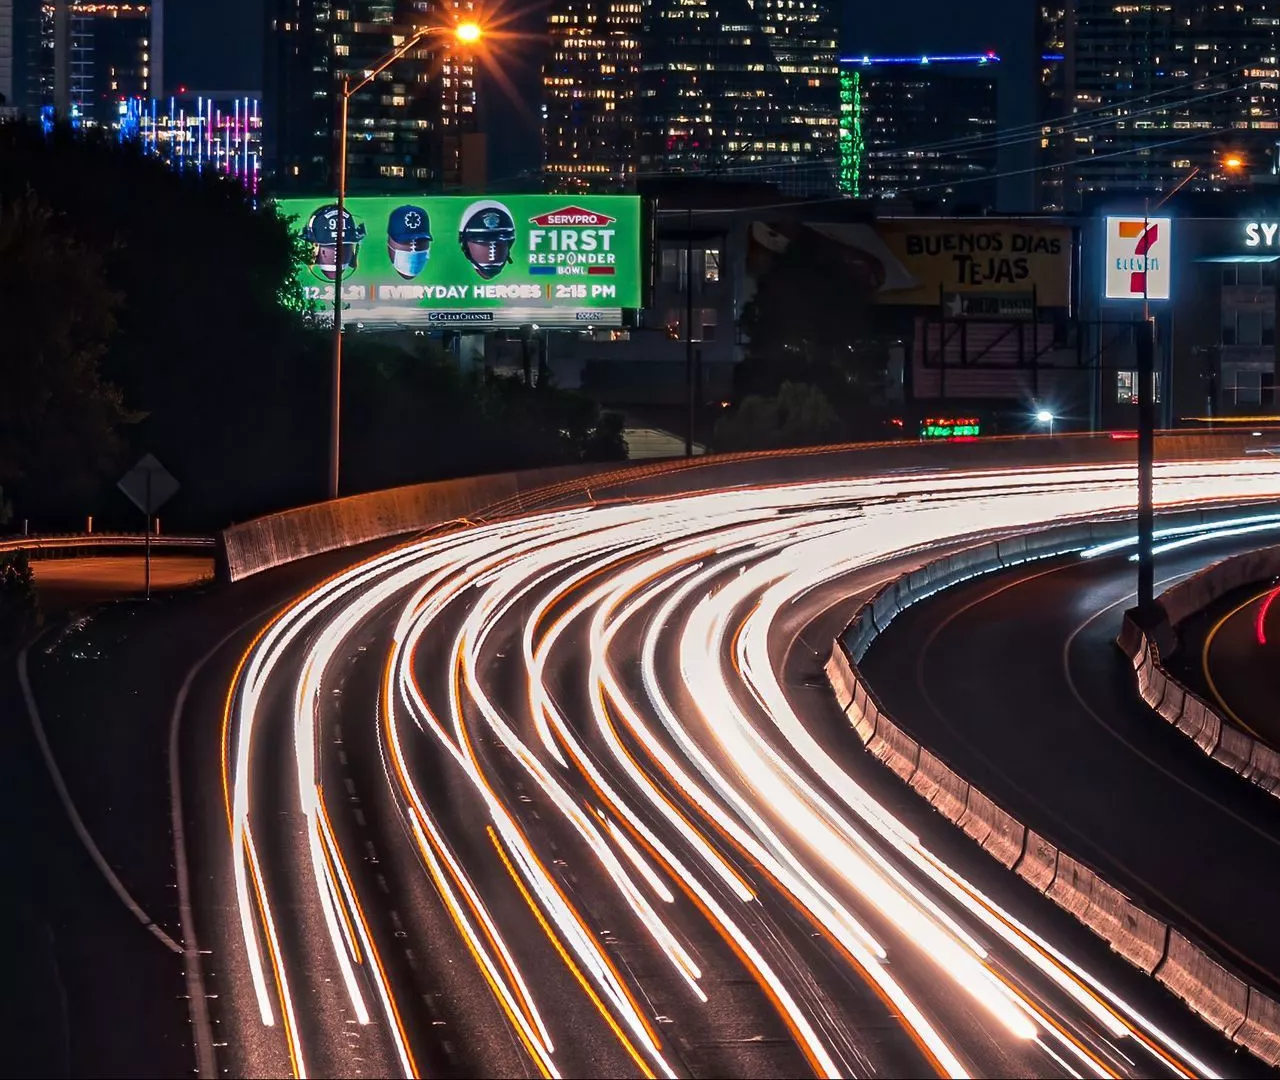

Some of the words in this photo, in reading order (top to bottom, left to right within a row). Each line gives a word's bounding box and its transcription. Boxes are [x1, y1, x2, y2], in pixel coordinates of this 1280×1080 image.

[328, 218, 347, 230] 91
[547, 215, 598, 224] SERVPRO
[906, 233, 1003, 256] BUENOS
[1011, 234, 1062, 255] DIAS
[529, 252, 616, 265] RESPONDER
[1118, 221, 1159, 293] 7
[557, 266, 585, 275] BOWL
[953, 254, 1030, 286] TEJAS
[379, 285, 469, 298] EVERYDAY
[474, 285, 542, 299] HEROES
[555, 284, 587, 298] 2:15
[591, 284, 616, 298] PM
